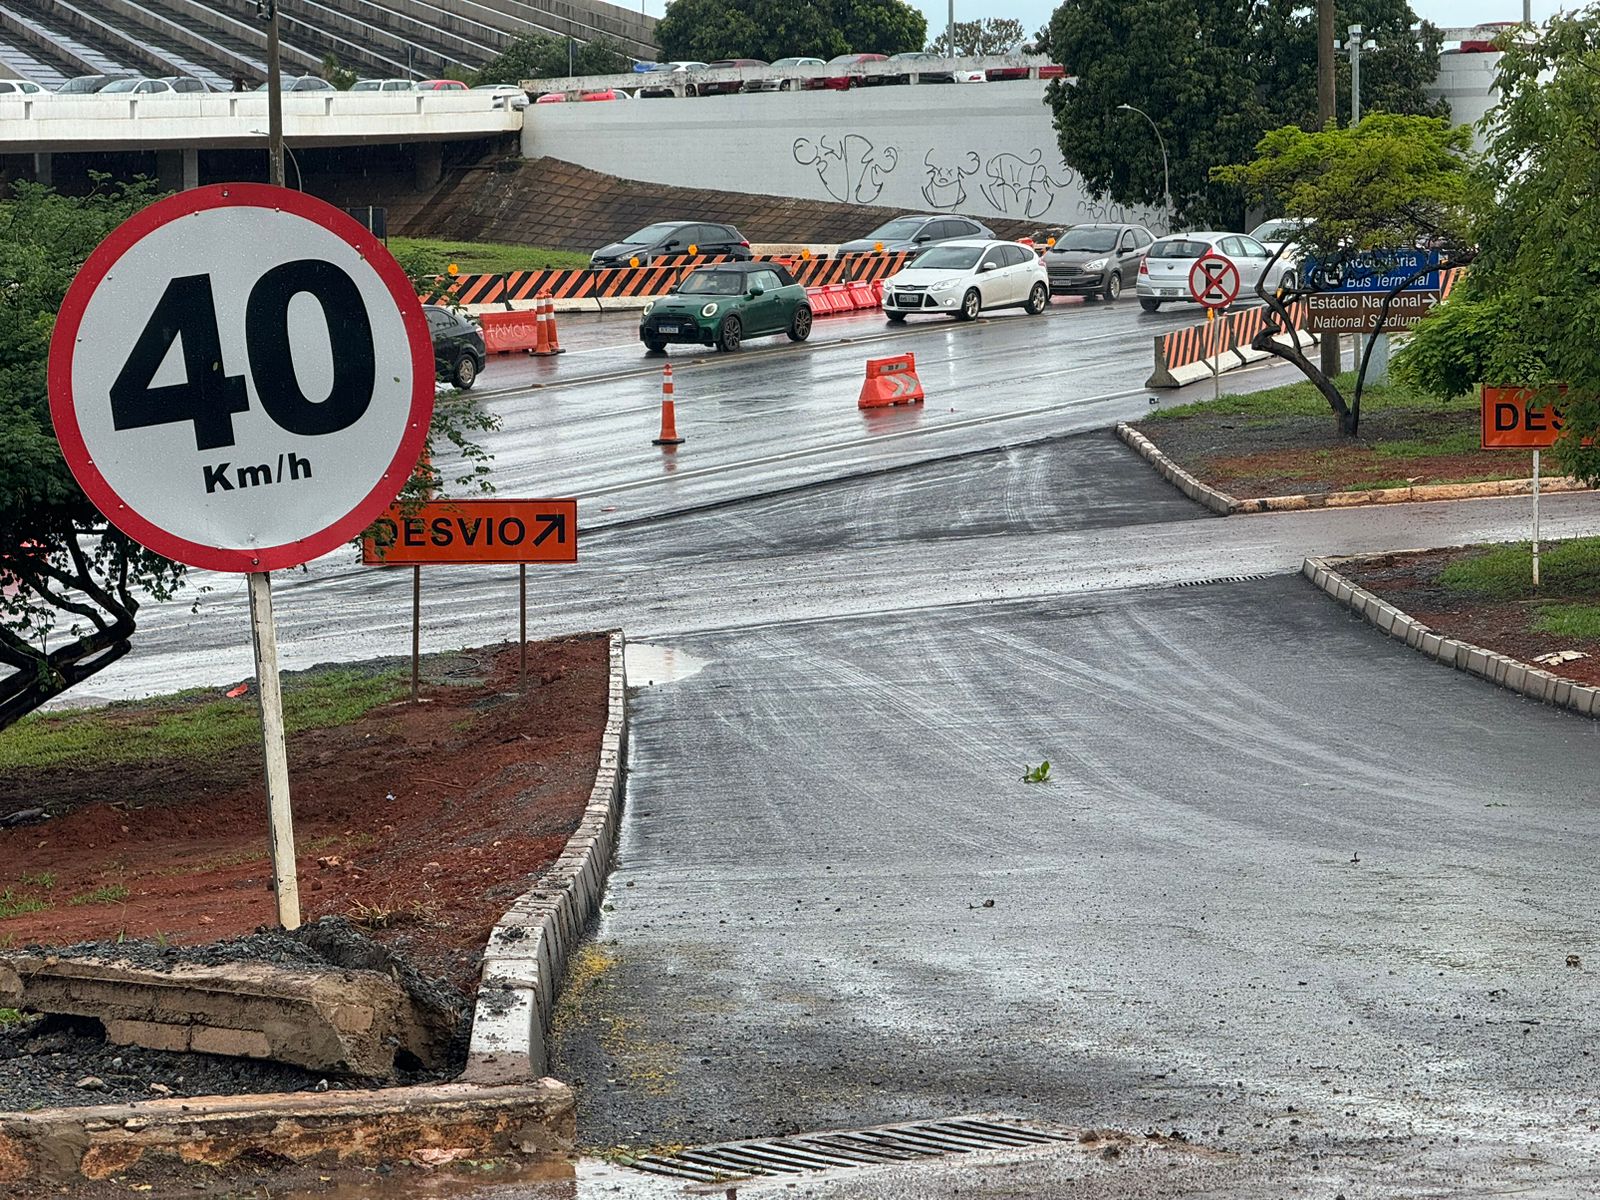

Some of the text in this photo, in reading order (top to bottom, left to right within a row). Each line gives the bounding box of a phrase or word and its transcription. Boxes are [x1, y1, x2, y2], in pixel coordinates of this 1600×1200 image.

[1346, 274, 1430, 288] Bus Termnal
[1309, 294, 1358, 309] Estádio
[1313, 314, 1421, 329] National Sadium
[109, 259, 376, 451] 40
[203, 452, 312, 494] Km/h
[374, 517, 526, 547] DESVIO
